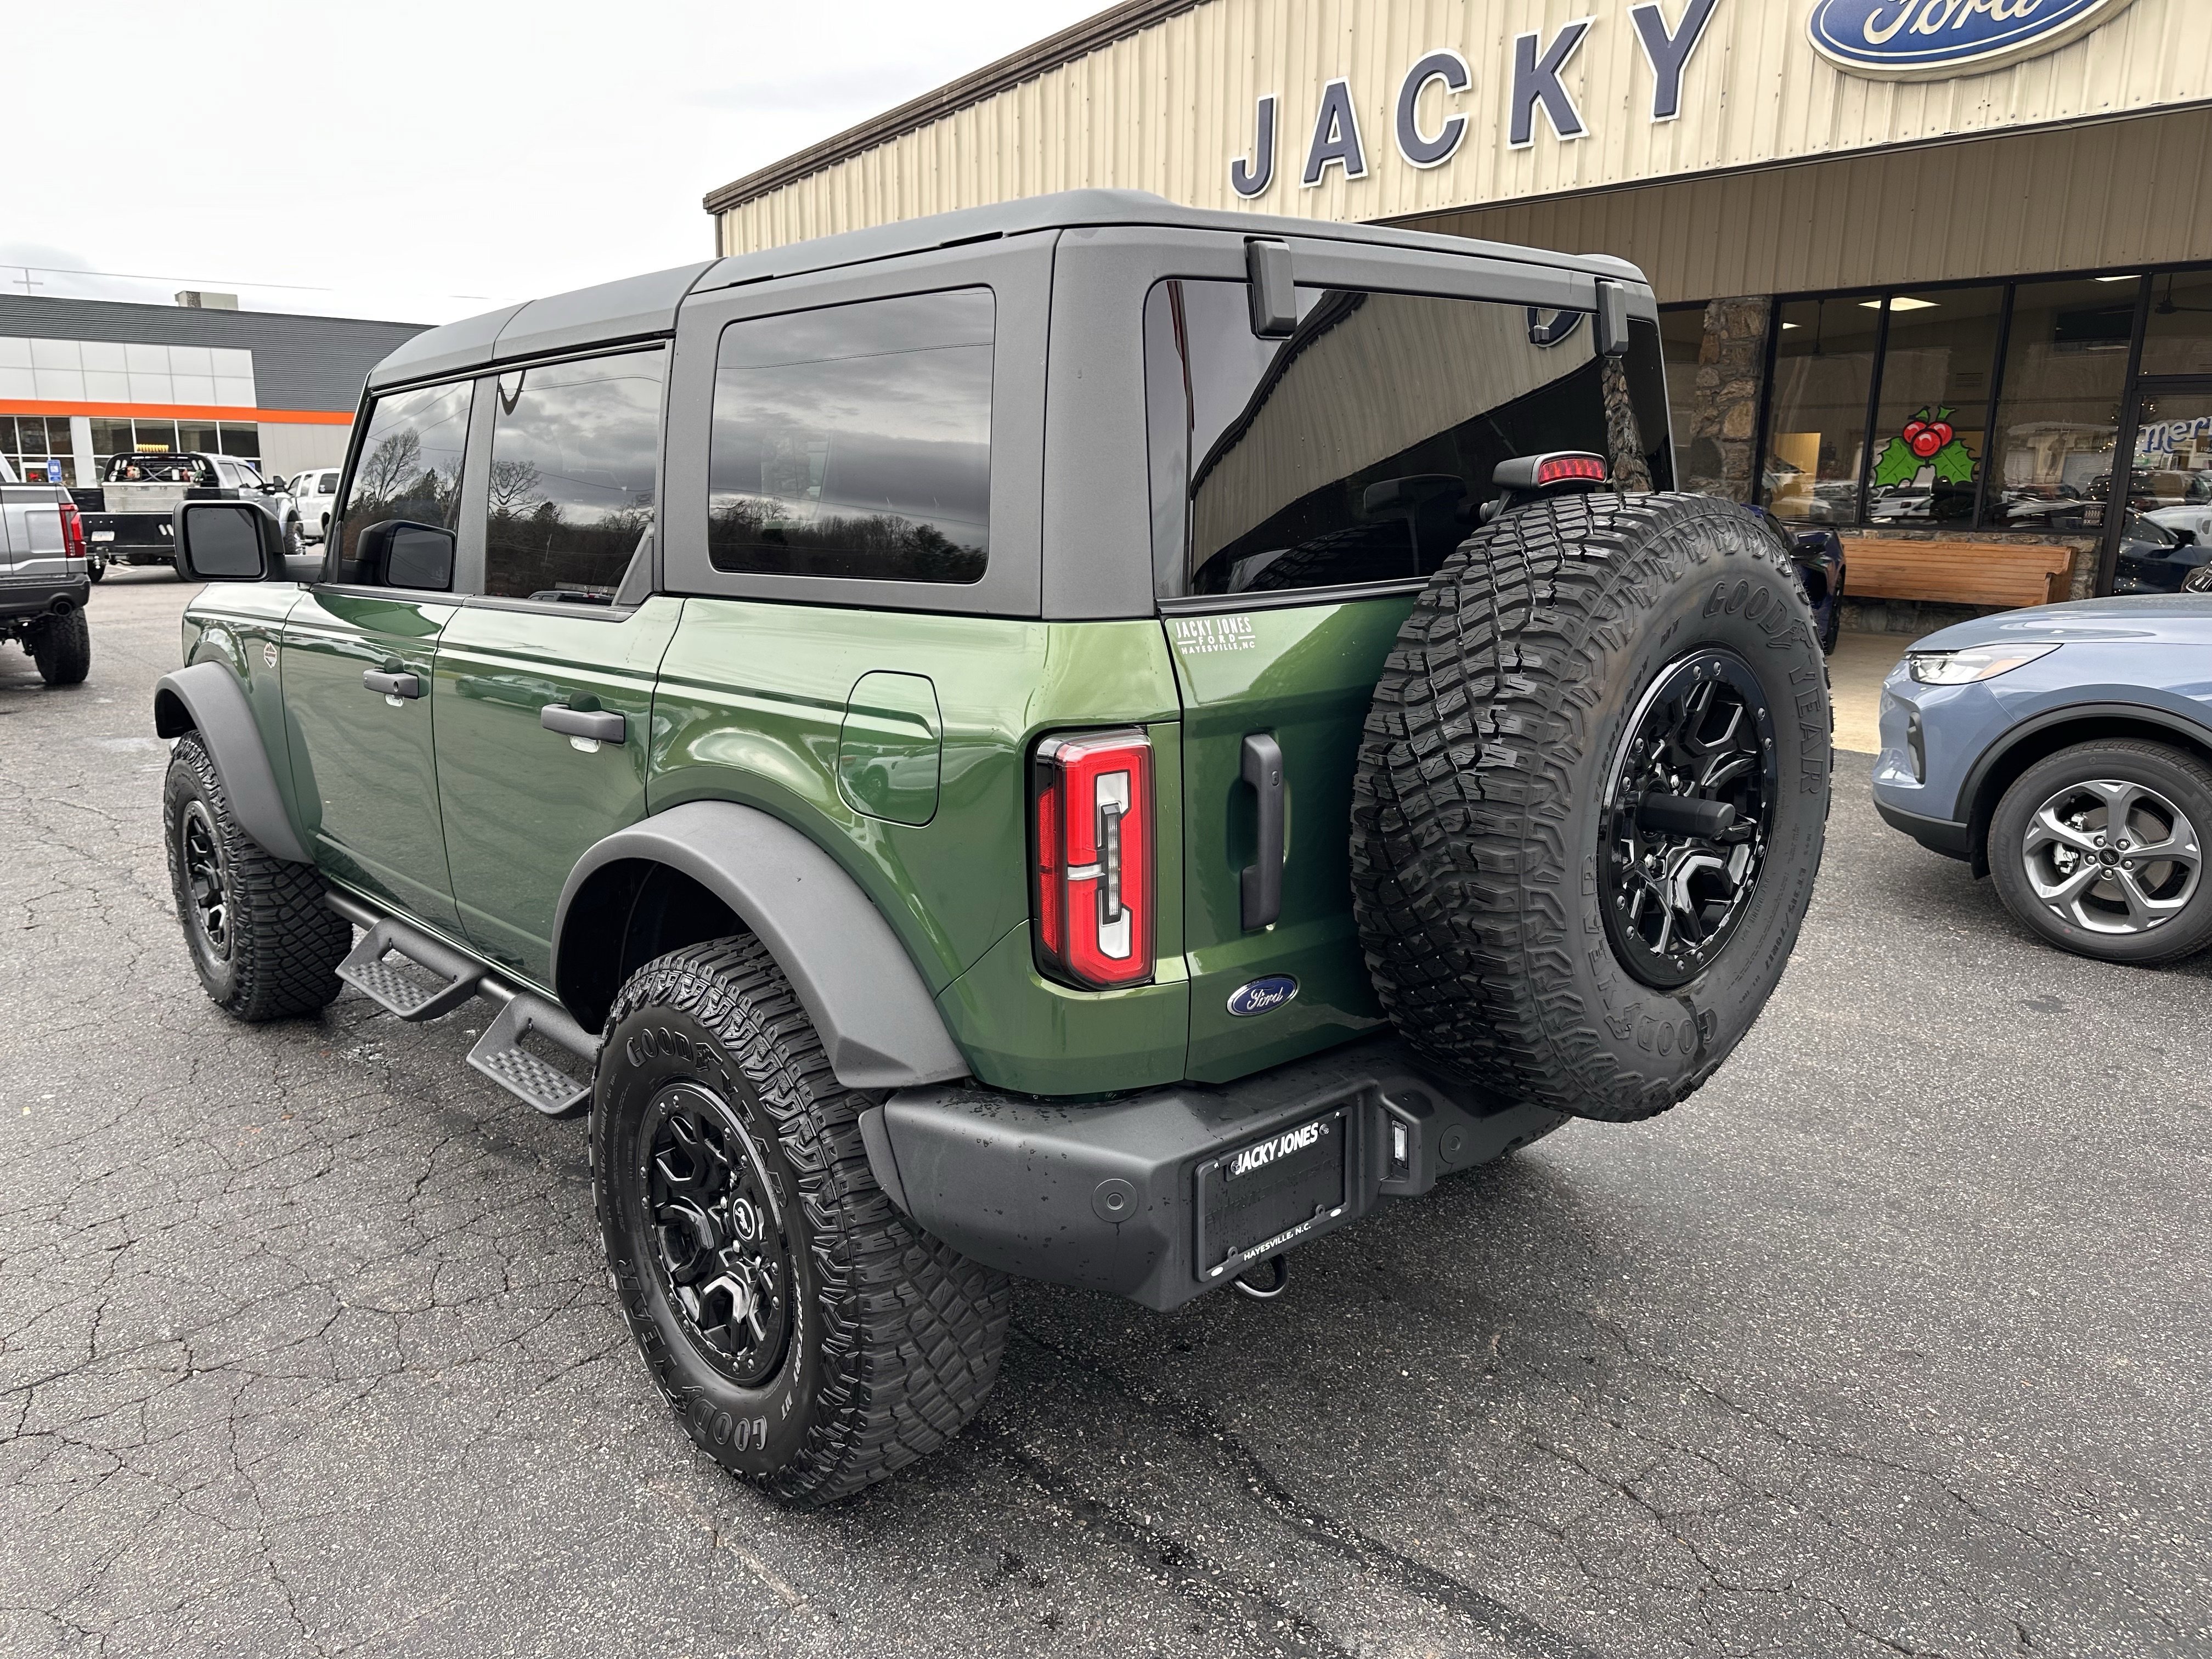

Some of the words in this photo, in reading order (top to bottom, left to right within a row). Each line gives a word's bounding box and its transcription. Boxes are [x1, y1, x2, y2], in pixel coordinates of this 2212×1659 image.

[1231, 0, 1720, 200] JACKY
[1176, 619, 1212, 639] JACKY
[1216, 616, 1252, 635] JONES
[1198, 634, 1235, 645] FORD
[1246, 986, 1283, 1011] Ford
[1235, 1139, 1279, 1175] JACKY
[1278, 1122, 1319, 1158] JONES
[1244, 1231, 1294, 1261] HAYESVILLE,
[1295, 1222, 1312, 1235] N.C.
